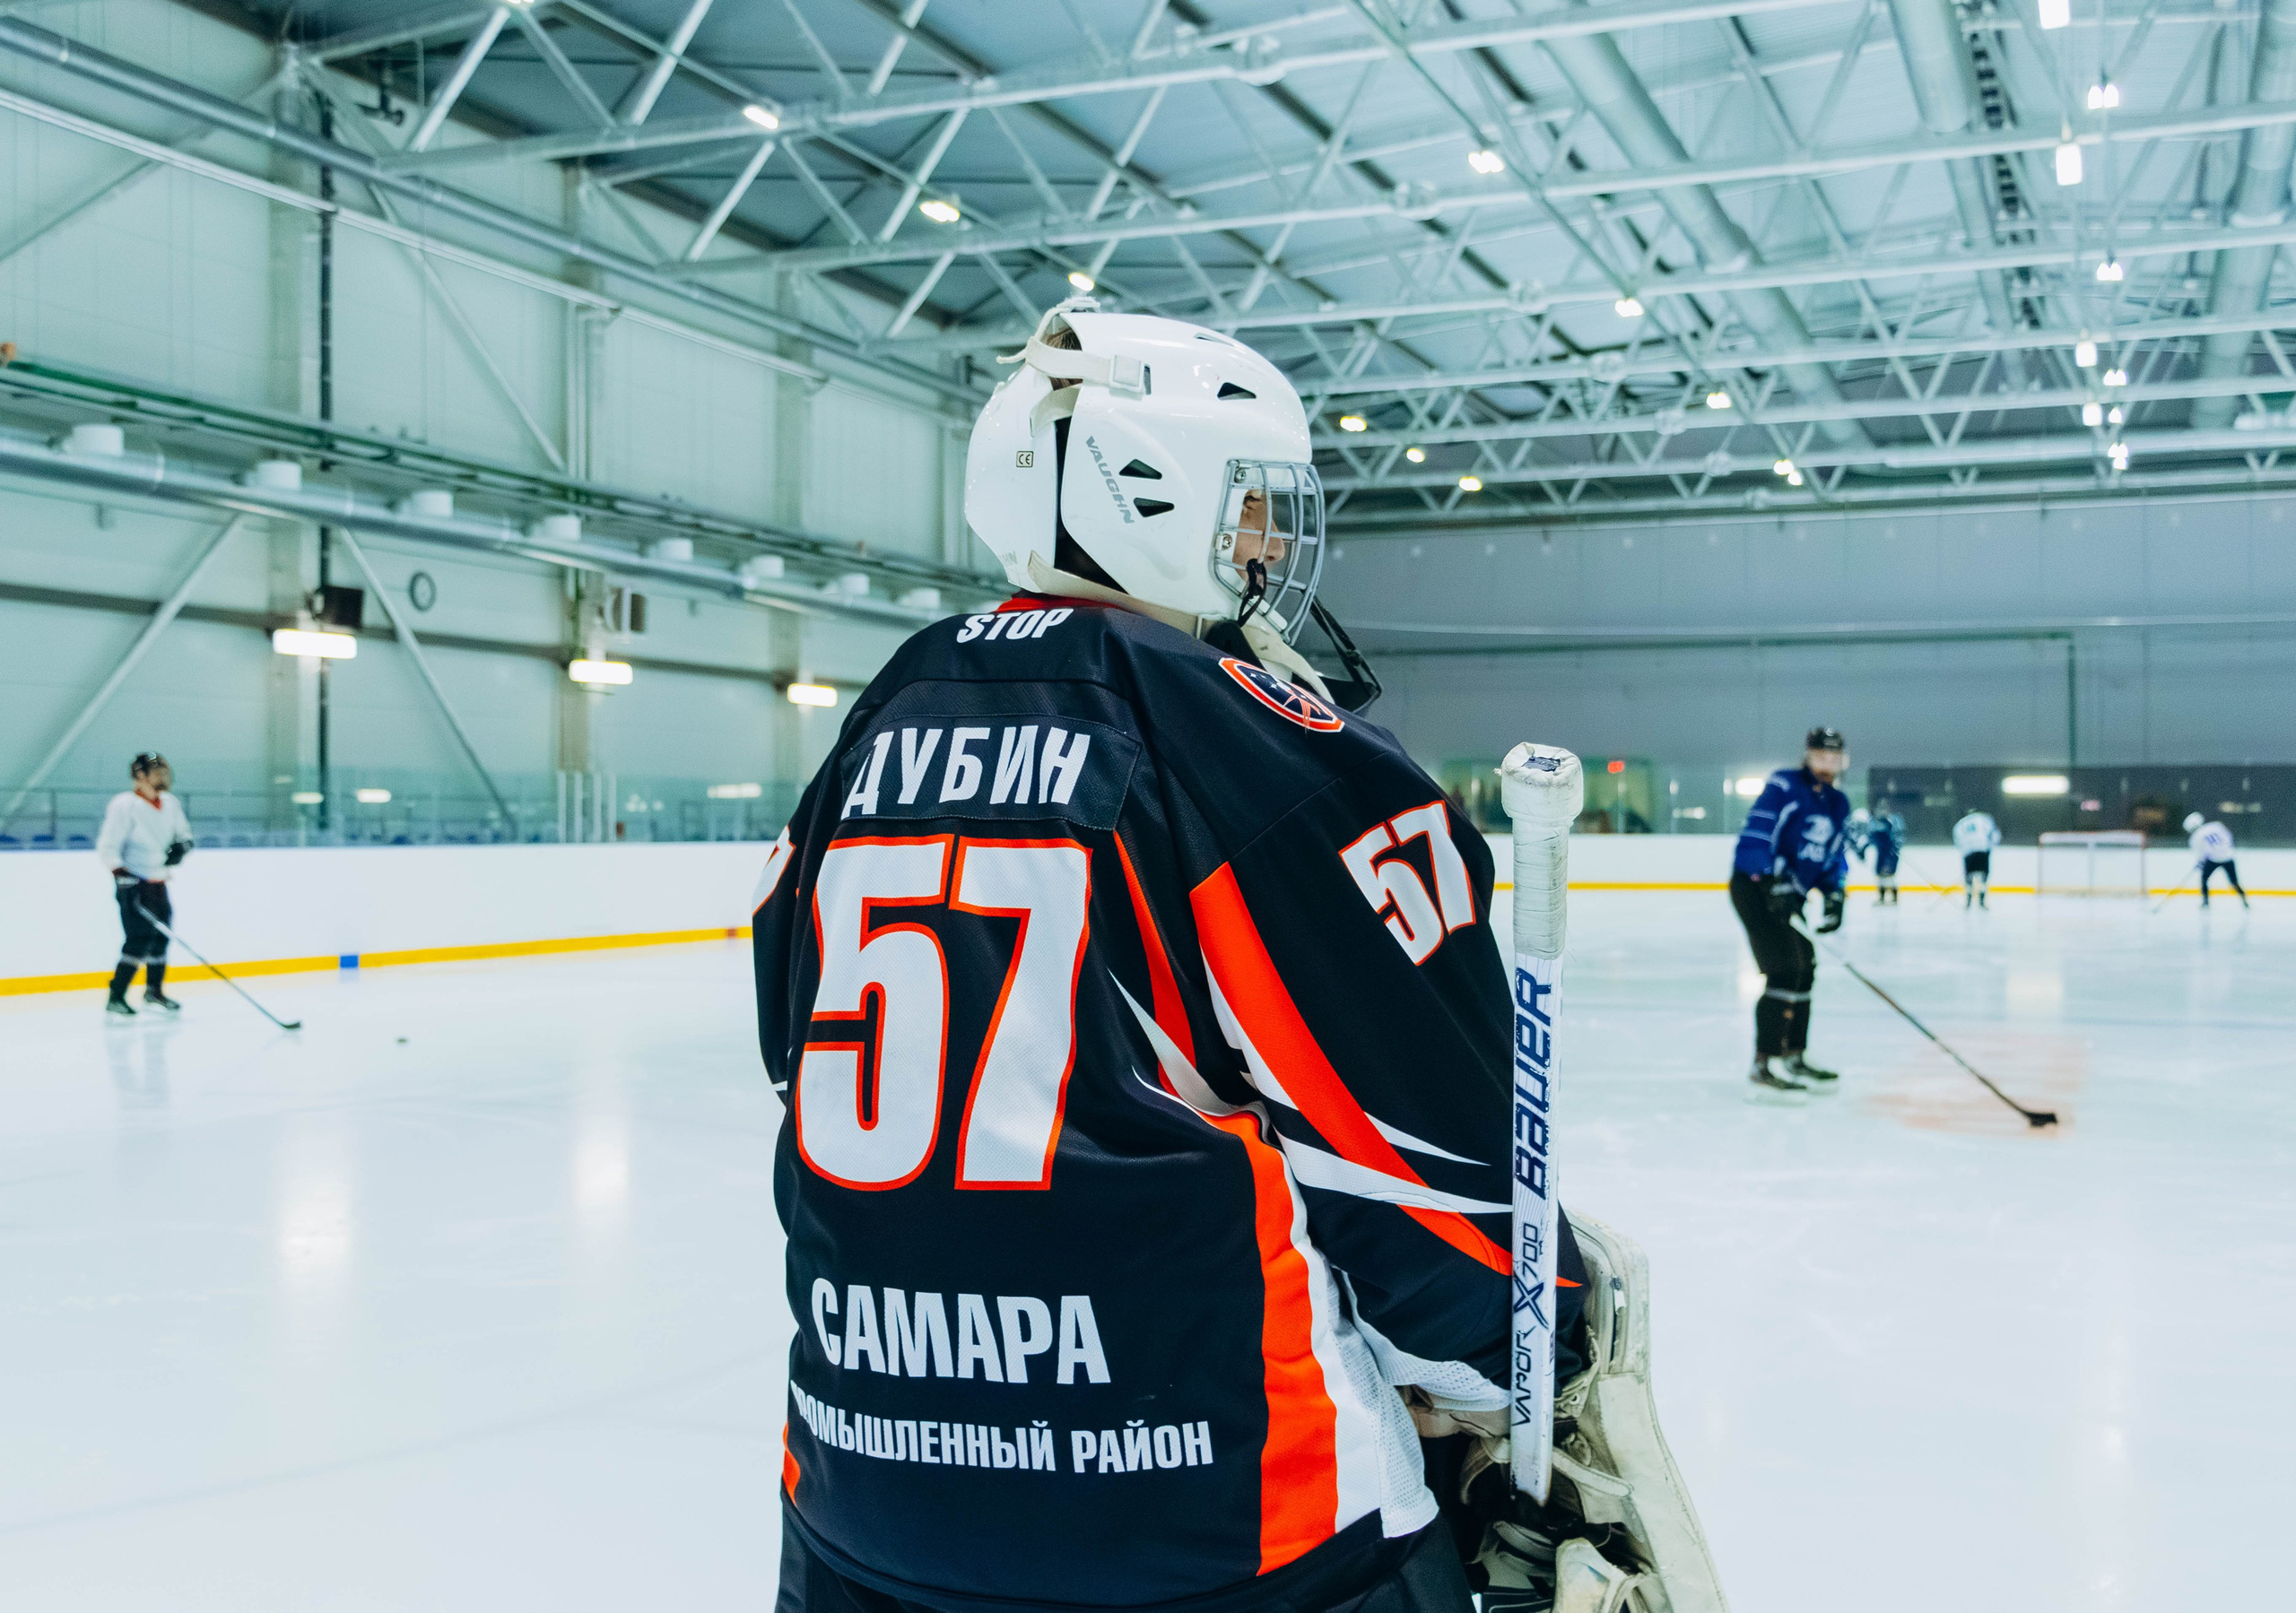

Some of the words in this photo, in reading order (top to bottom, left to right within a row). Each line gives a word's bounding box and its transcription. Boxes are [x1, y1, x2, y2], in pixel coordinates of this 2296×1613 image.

[1017, 453, 1032, 465] CE
[1086, 436, 1135, 524] VAUGHN
[957, 609, 1074, 643] STOP
[840, 724, 1091, 820] ДУБИН
[1338, 800, 1476, 966] 57
[796, 833, 1093, 1192] 57
[811, 1278, 1111, 1384] САМАРА
[1512, 1325, 1536, 1427] VAPOR
[1071, 1419, 1213, 1473] РАЙОН
